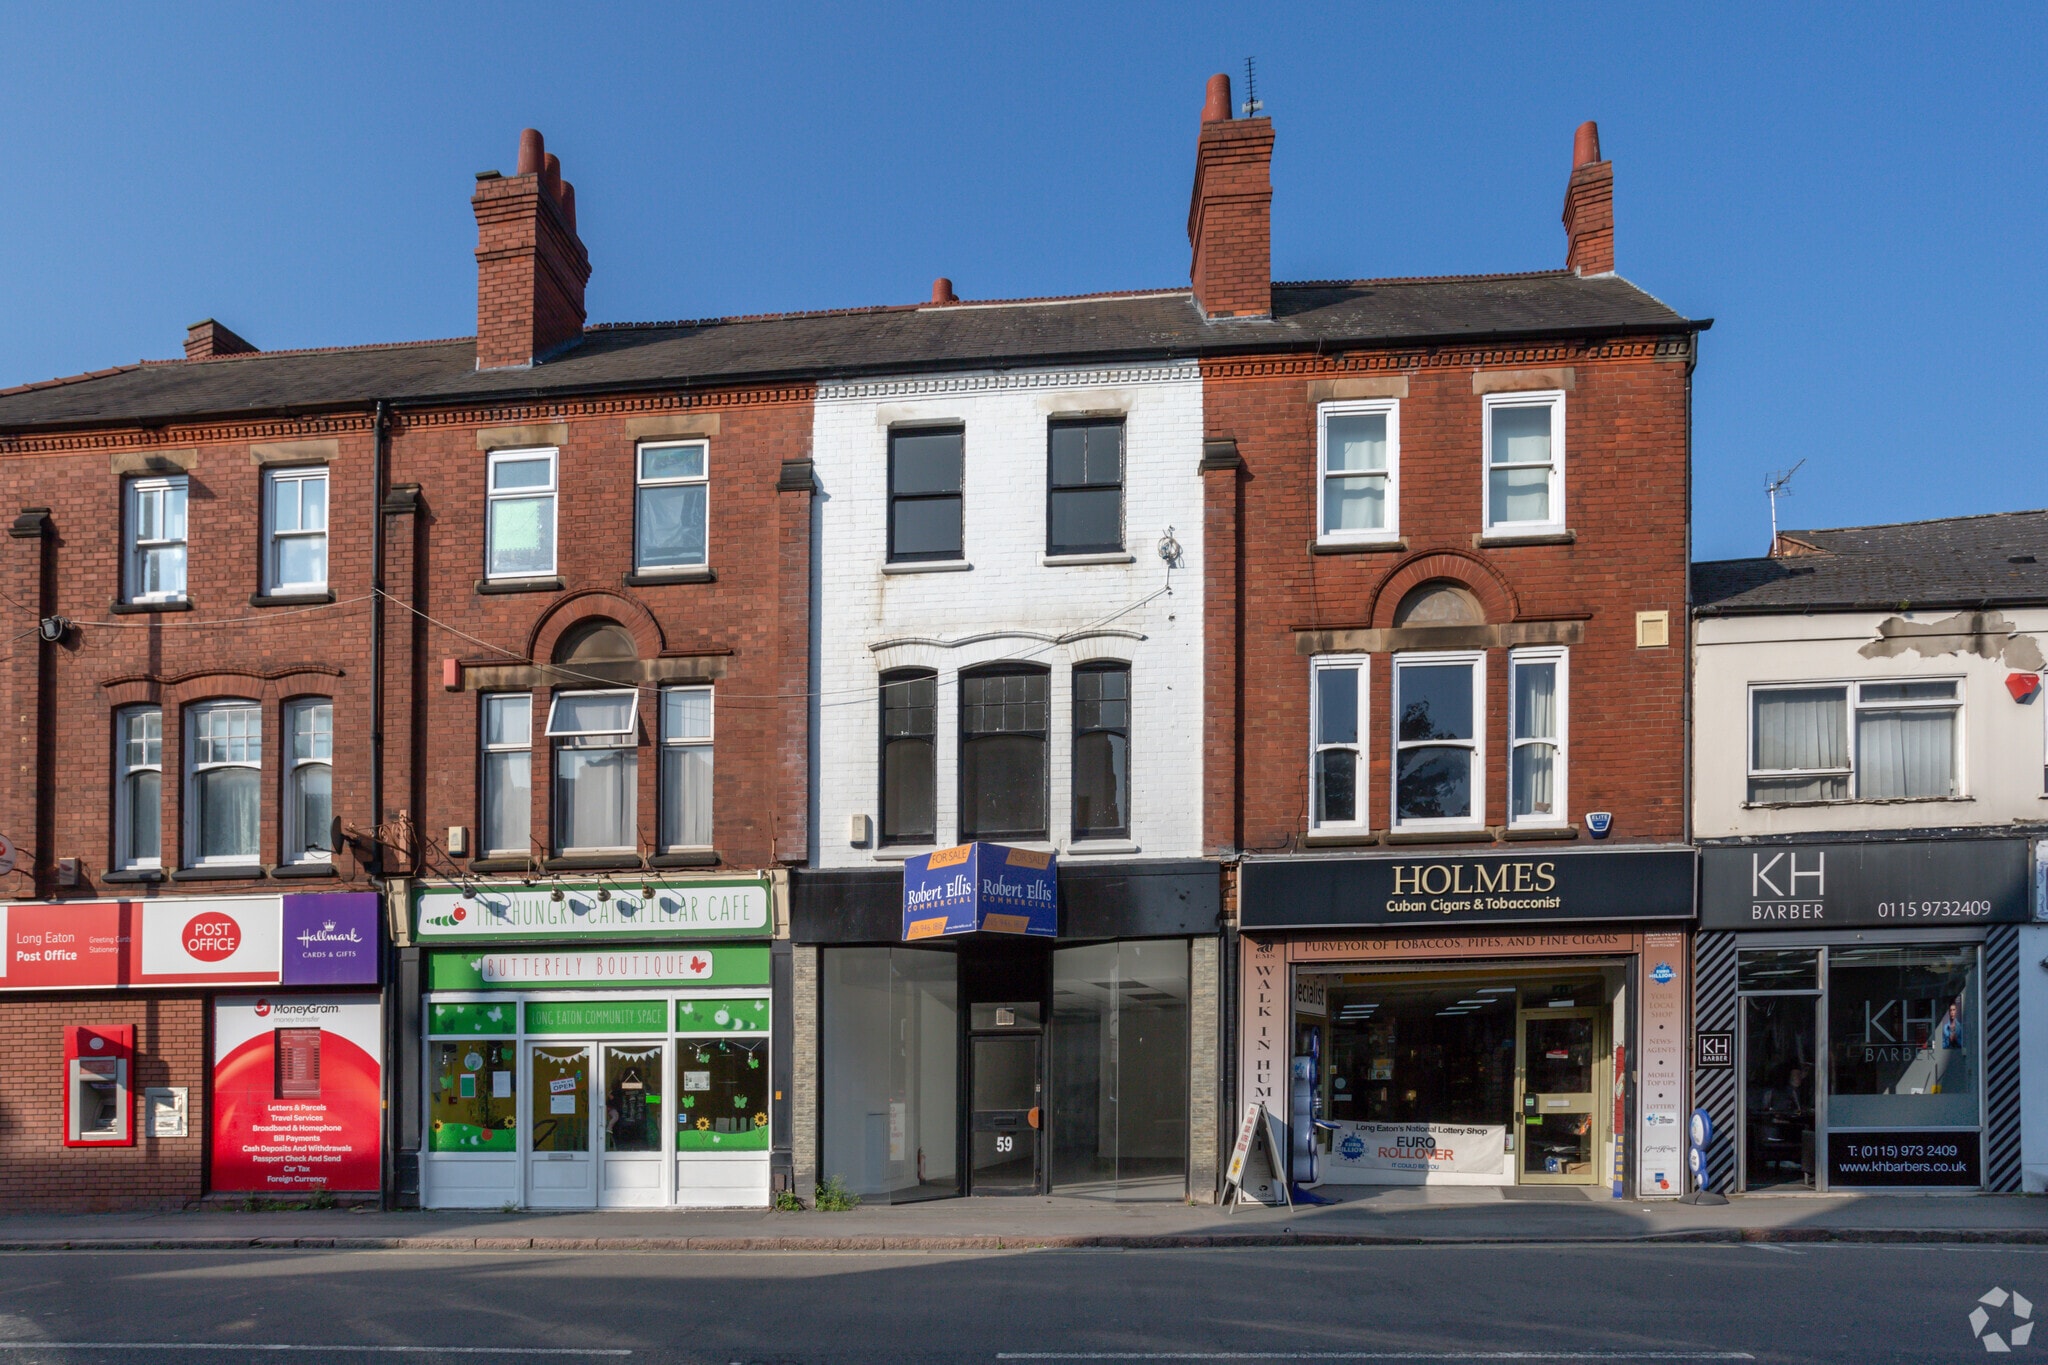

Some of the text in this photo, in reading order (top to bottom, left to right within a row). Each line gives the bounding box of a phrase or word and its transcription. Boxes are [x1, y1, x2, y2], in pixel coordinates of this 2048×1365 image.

[932, 848, 966, 864] FOR SALE
[1010, 850, 1046, 866] FOR SALE
[1392, 862, 1556, 895] HOLMES
[1753, 852, 1824, 896] KH
[908, 874, 972, 906] Robert Ellis
[982, 875, 1052, 901] Robert Ellis
[908, 896, 971, 912] COMMERCIAL
[982, 895, 1051, 908] COMMERCIAL
[1386, 896, 1561, 914] Cuban Cigars & Tobacconist
[1878, 900, 1992, 918] 0115 9732409
[475, 894, 750, 926] THE HUNGRY CATERPILLAR CAFE
[1752, 904, 1824, 920] BARBER
[195, 922, 232, 936] POST
[16, 932, 75, 946] Long Eaton
[89, 936, 114, 944] Greeting
[188, 937, 235, 952] OFFICE
[296, 928, 362, 948] Hallmark
[1304, 934, 1618, 952] PURVEYOR OF TOBACCOS, PIPES, AND FINE CIGARS
[16, 950, 77, 962] Post Office
[488, 955, 684, 977] BUTTERFLY BOUTIQUE
[1255, 966, 1275, 1016] WALK
[274, 1004, 339, 1016] MoneyGram
[532, 1008, 662, 1025] LONG EATON COMMUNITY SPACE
[1865, 1000, 1936, 1042] KH
[1258, 1026, 1272, 1050] IN
[1703, 1038, 1728, 1054] KH
[1865, 1048, 1936, 1062] BARBER
[553, 1082, 574, 1091] OPEN
[299, 1124, 342, 1132] Homephone
[1356, 1123, 1375, 1132] Long
[1376, 1124, 1404, 1132] Eaton's
[1438, 1126, 1465, 1136] Lottery
[1467, 1128, 1488, 1136] Shop
[286, 1134, 320, 1142] Payments
[996, 1136, 1013, 1152] 59
[1396, 1136, 1436, 1148] EURO
[260, 1145, 292, 1153] Deposits
[1378, 1146, 1454, 1161] ROLLOVER
[1848, 1145, 1958, 1158] T: (0115) 973 2409
[1839, 1161, 1967, 1172] www.khbarbers.co.uk
[267, 1176, 328, 1184] Foreign Currency
